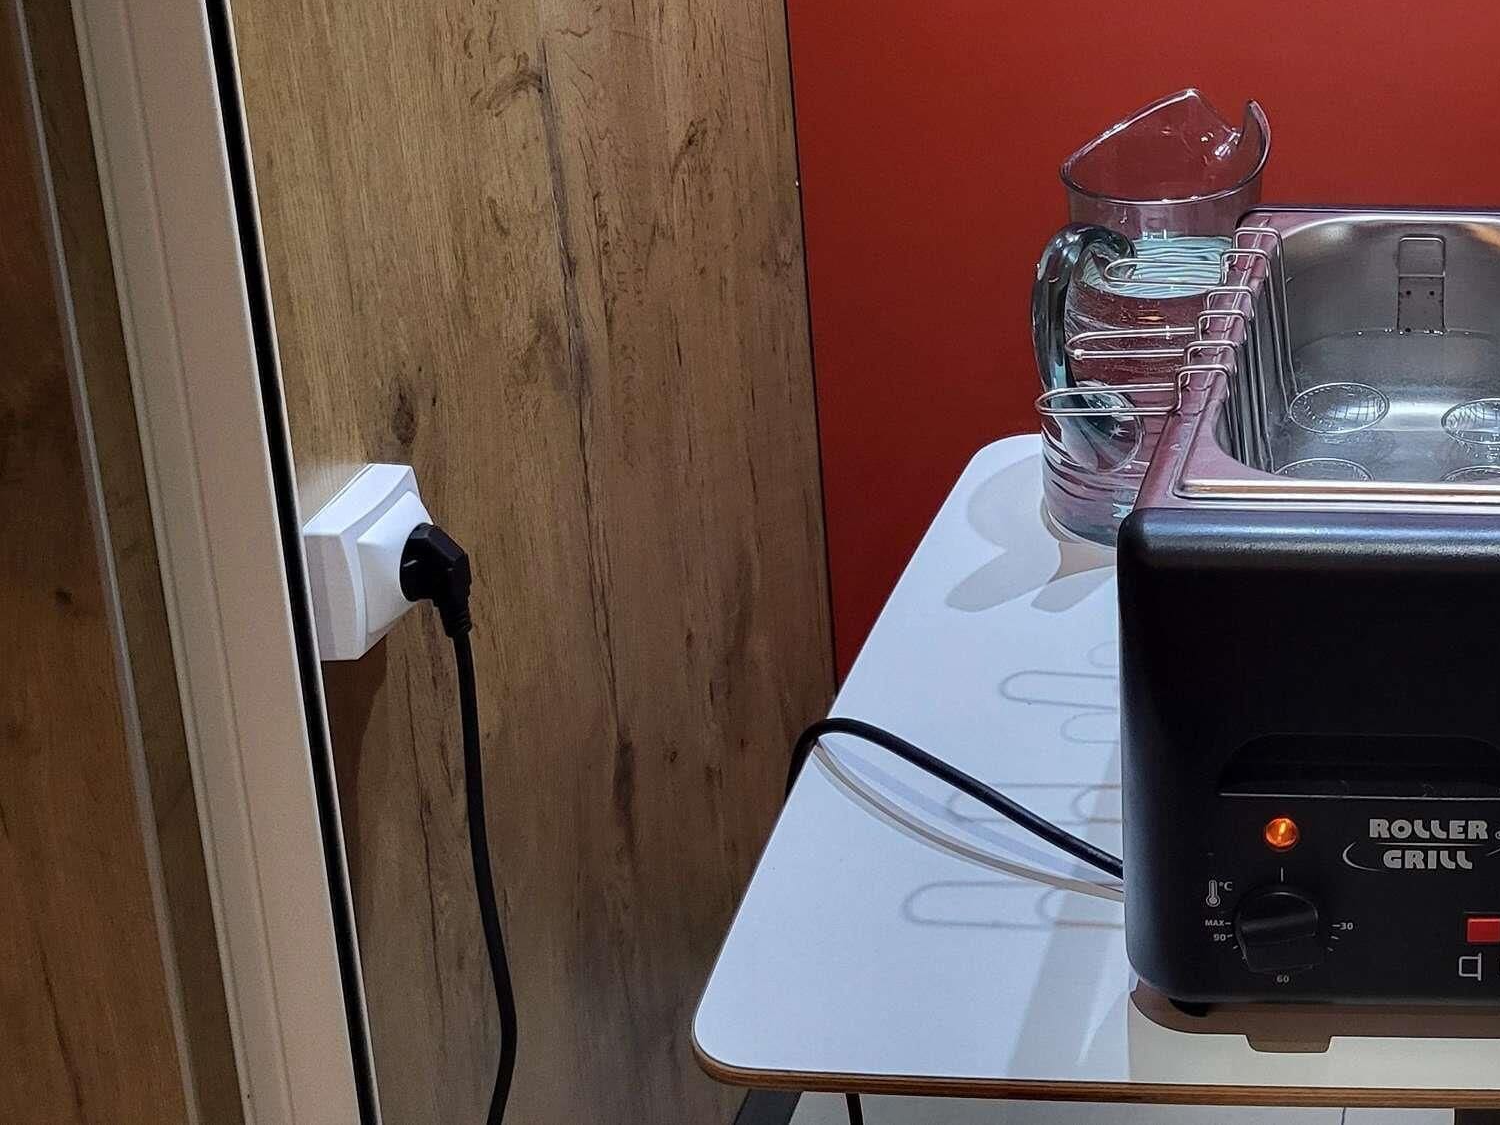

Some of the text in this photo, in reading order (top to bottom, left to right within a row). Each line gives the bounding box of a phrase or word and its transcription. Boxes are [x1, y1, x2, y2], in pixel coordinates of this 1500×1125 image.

[1368, 818, 1489, 840] ROLLER
[1382, 849, 1473, 870] GRILL
[1204, 919, 1225, 927] MAX
[1339, 922, 1354, 931] 30
[1213, 933, 1227, 942] 90
[1276, 975, 1290, 984] 60
